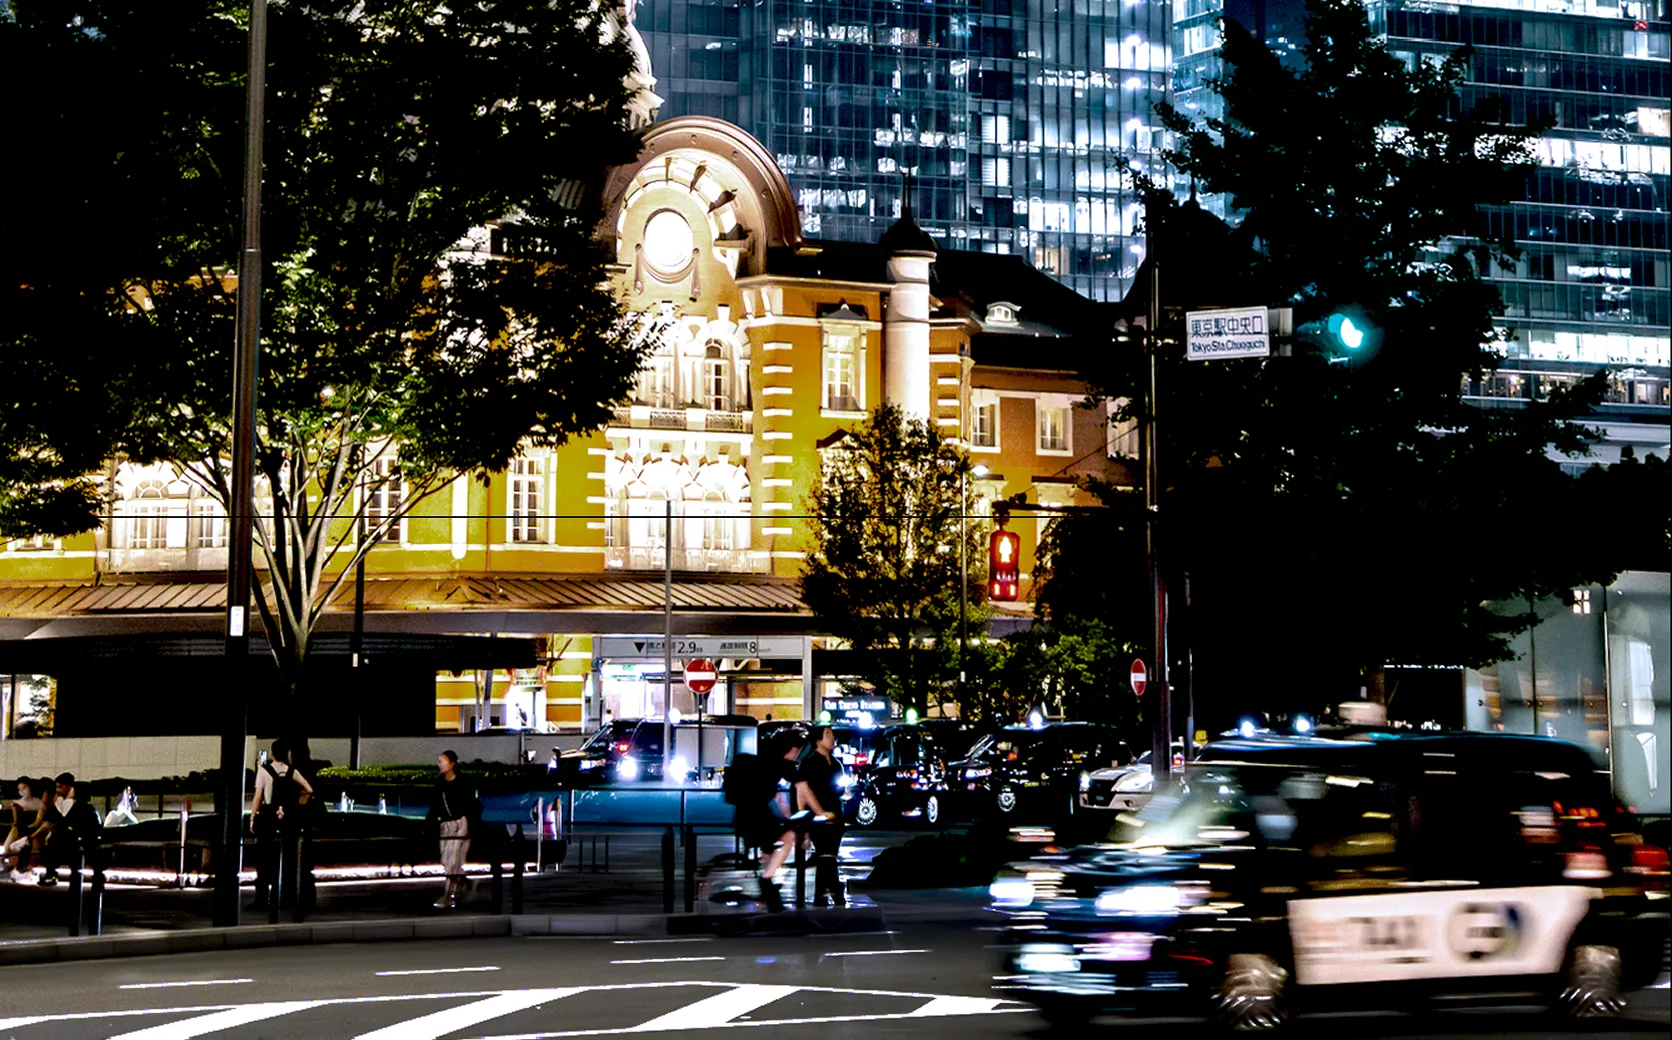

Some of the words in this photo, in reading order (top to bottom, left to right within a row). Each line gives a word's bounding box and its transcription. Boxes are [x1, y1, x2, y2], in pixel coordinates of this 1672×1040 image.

[1191, 316, 1263, 338] 東京駅中央口
[1191, 341, 1212, 354] Tokyo
